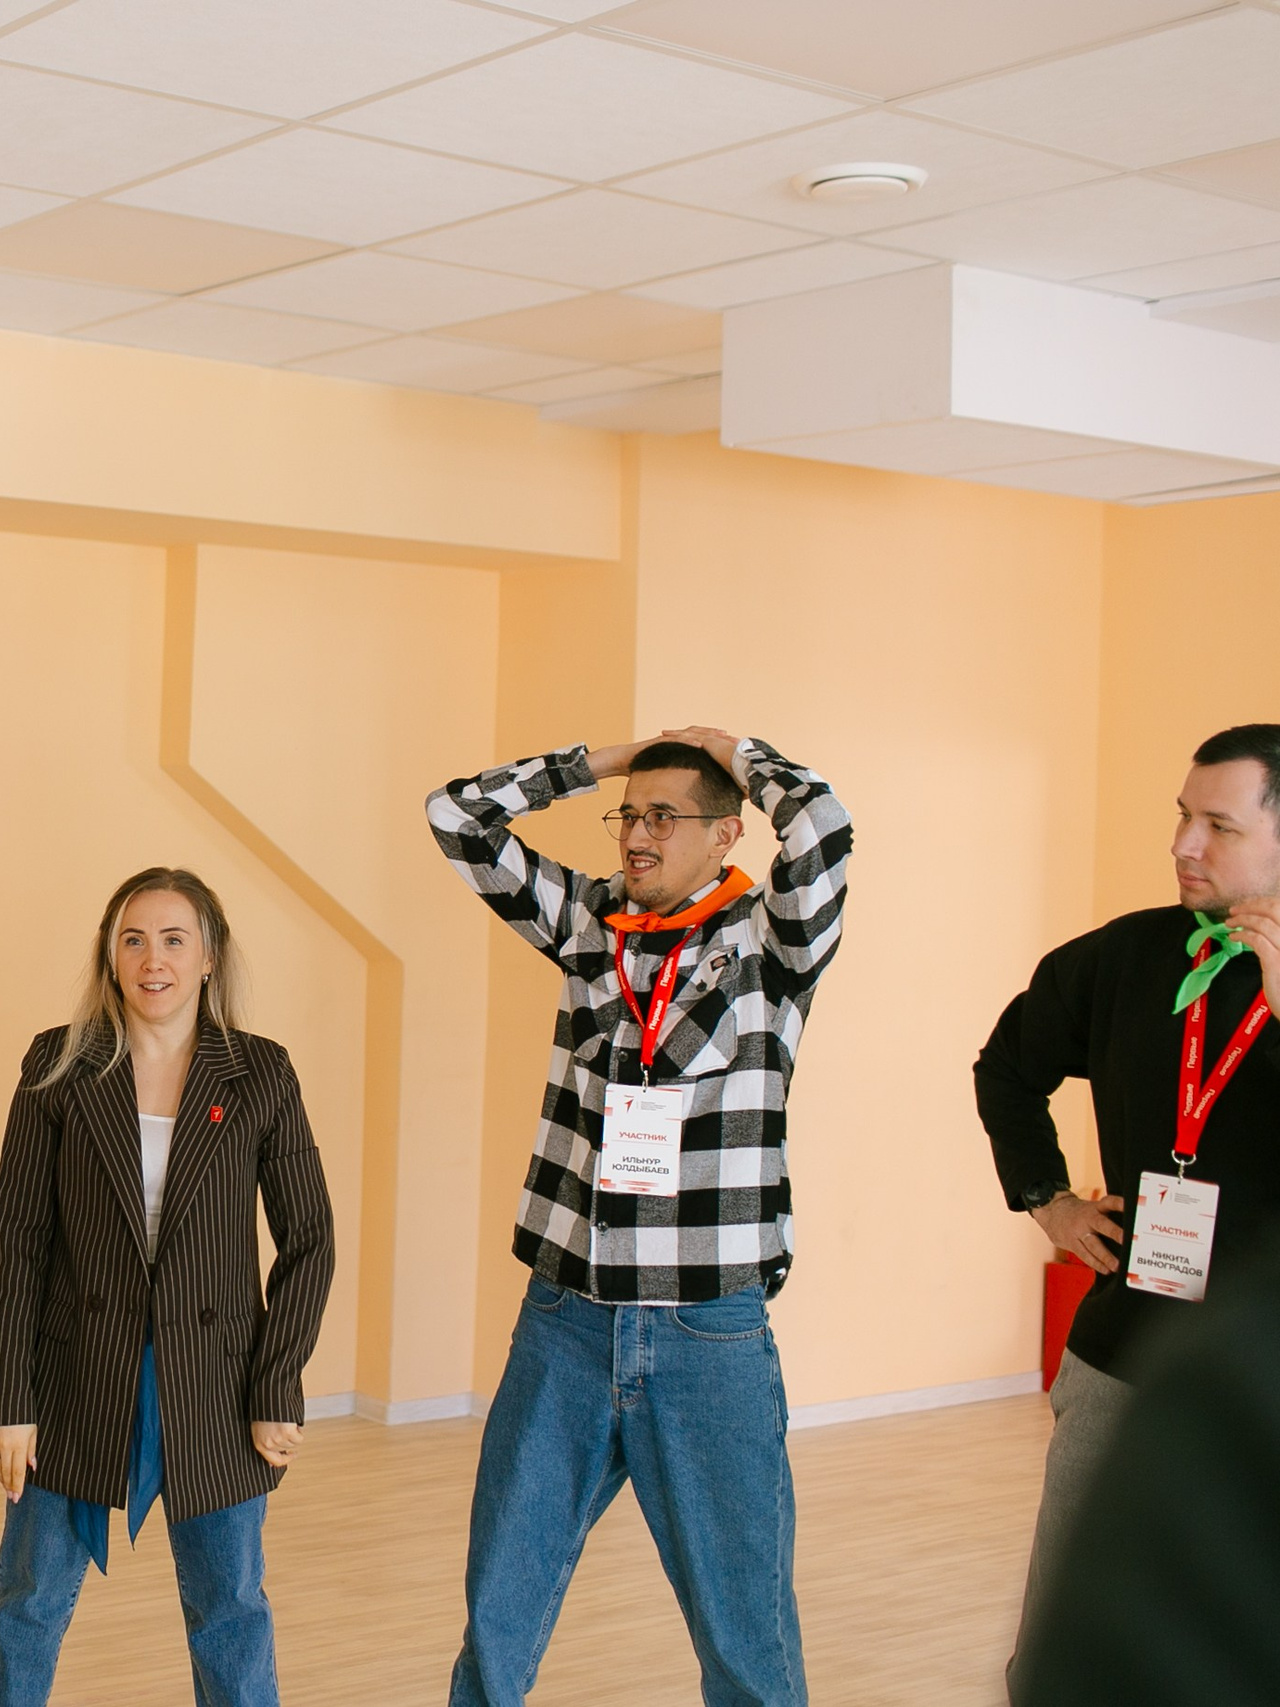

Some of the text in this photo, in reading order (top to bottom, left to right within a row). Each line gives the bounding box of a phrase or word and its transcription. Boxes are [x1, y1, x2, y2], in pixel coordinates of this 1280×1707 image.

[660, 957, 674, 987] Первые
[649, 999, 664, 1030] Первые
[1244, 1004, 1268, 1035] Первые
[1186, 1036, 1198, 1068] Первые
[1219, 1046, 1242, 1076] Первые
[1193, 1088, 1216, 1119] Первые
[619, 1131, 668, 1142] УЧАСТНИК
[612, 1163, 670, 1175] ЮЛДЫБАЕВ
[622, 1156, 661, 1165] ИЛЬНУР
[1150, 1223, 1199, 1239] УЧАСТНИК
[1136, 1256, 1203, 1277] ВИНОГРАДОВ
[1151, 1250, 1190, 1265] НИКИТА
